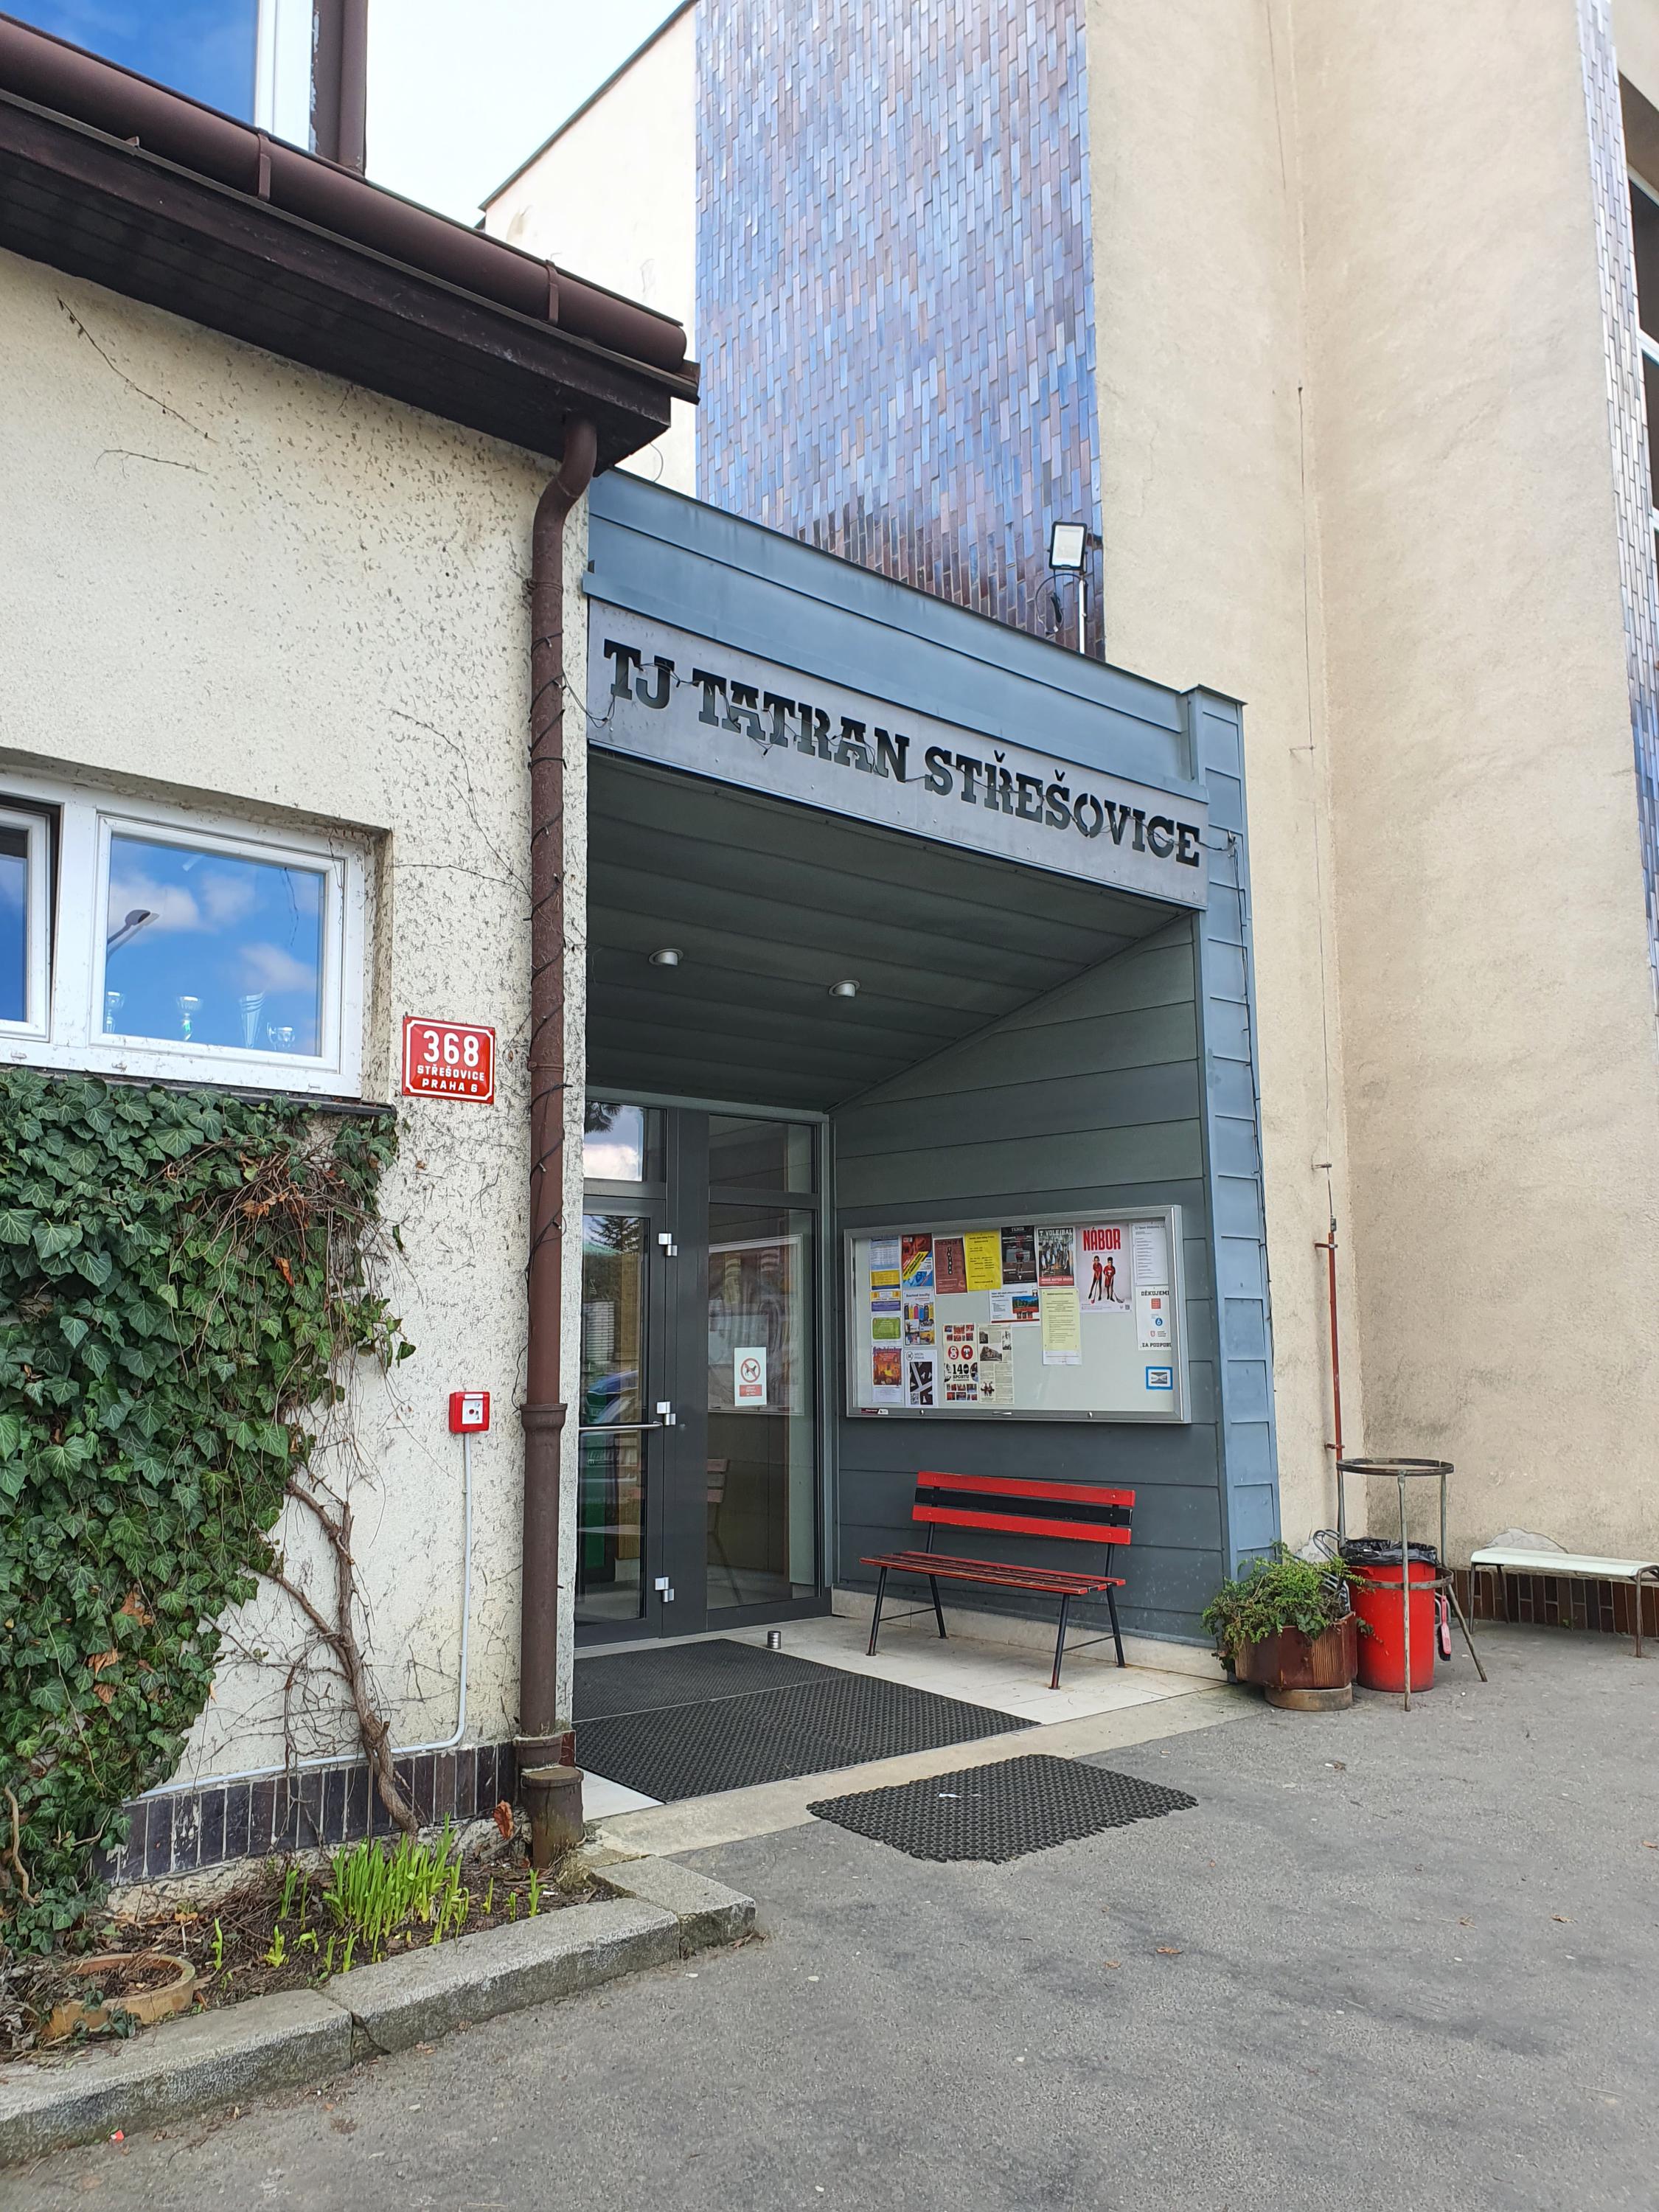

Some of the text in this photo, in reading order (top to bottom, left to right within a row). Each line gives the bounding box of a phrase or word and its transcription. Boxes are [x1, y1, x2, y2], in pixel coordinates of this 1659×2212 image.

[604, 639, 1200, 867] TJ TATRAN STŘEŠOVICE
[423, 1030, 479, 1067] 368
[417, 1064, 485, 1082] STŘEŠOVICE
[422, 1078, 478, 1093] PRAHA 6
[1083, 1227, 1121, 1251] NÁBOR
[953, 1363, 969, 1374] 140
